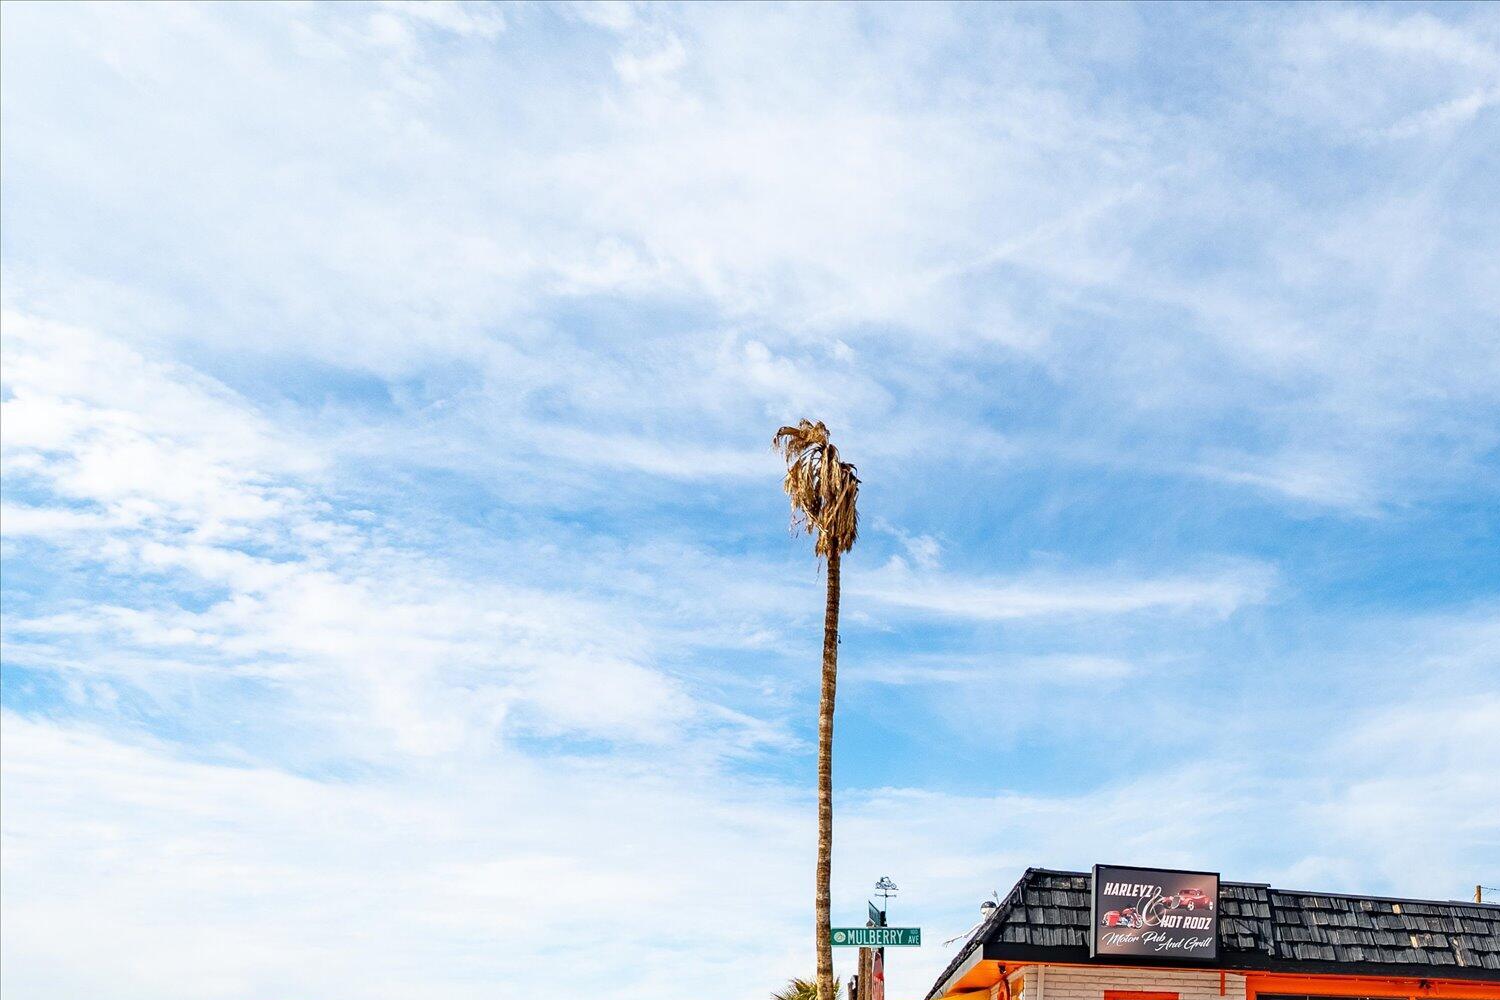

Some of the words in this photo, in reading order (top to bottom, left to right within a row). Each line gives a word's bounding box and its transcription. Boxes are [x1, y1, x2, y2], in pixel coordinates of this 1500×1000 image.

[1103, 882, 1154, 898] HARLEYZ
[1160, 915, 1183, 929] HOT
[1183, 916, 1212, 930] RODZ
[848, 929, 904, 944] MULBERRY
[907, 935, 919, 944] AVE
[1101, 932, 1140, 946] Motor
[1141, 931, 1166, 945] Pub
[1155, 937, 1184, 951] And
[1183, 936, 1212, 951] Grill
